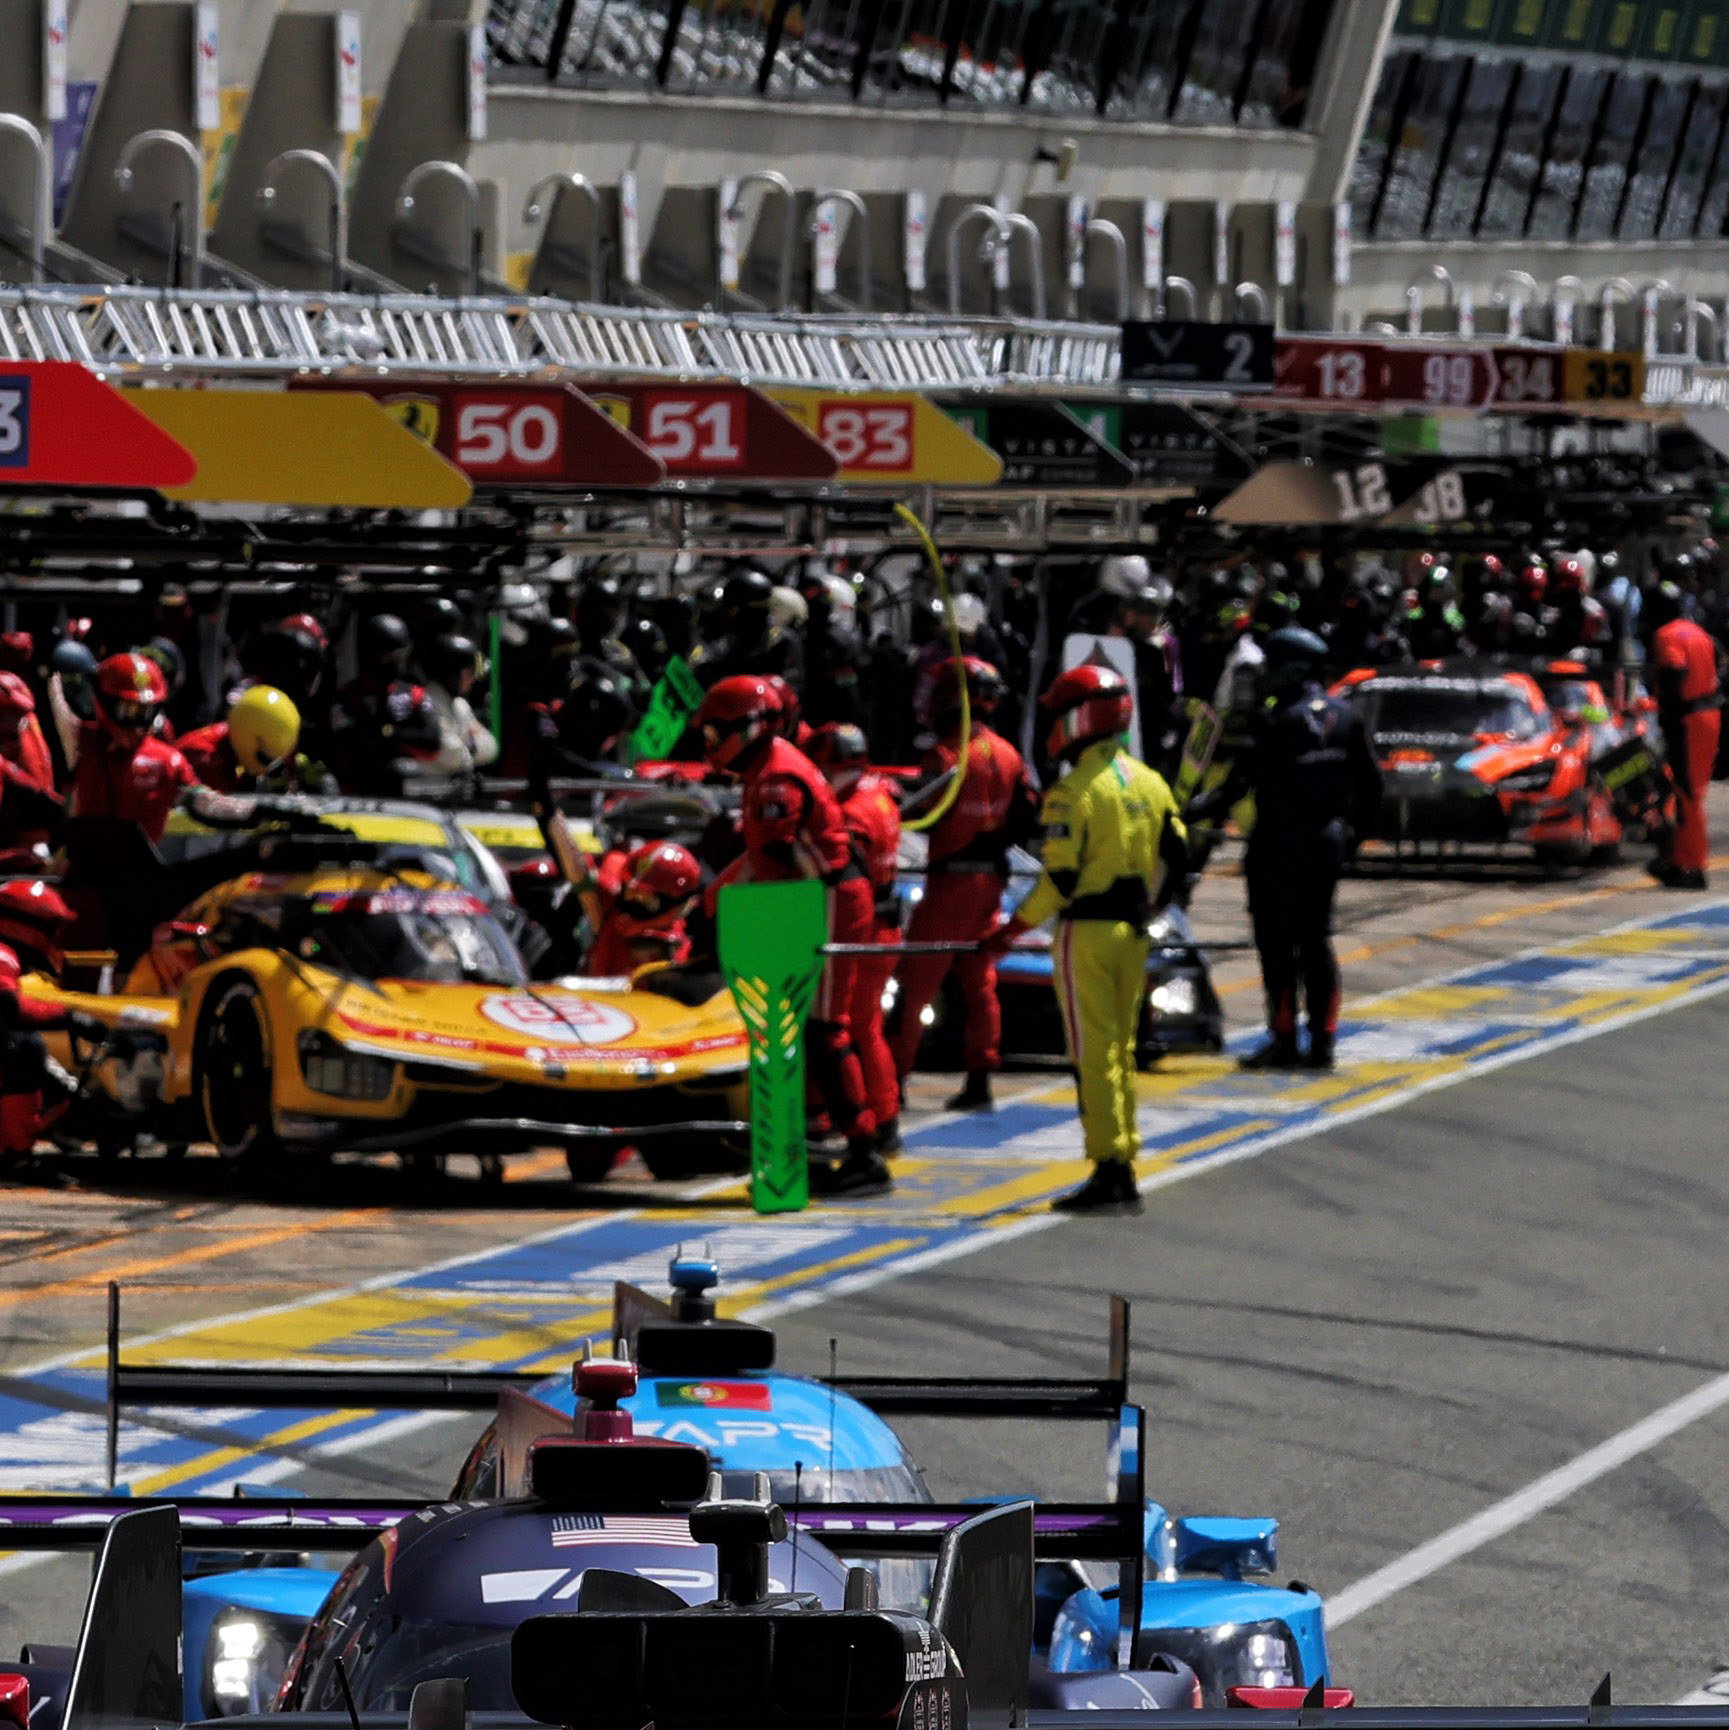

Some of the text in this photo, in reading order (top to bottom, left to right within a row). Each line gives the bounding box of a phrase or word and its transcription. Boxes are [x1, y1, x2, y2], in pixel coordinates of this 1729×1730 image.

[1223, 334, 1253, 381] 2
[1316, 353, 1367, 398] 13
[1423, 355, 1473, 401] 99
[1502, 357, 1555, 399] 34
[1586, 359, 1633, 399] 33
[458, 405, 558, 464] 50
[648, 403, 740, 461] 51
[822, 411, 913, 463] 83
[1333, 464, 1392, 520] 12
[664, 1418, 834, 1452] APR
